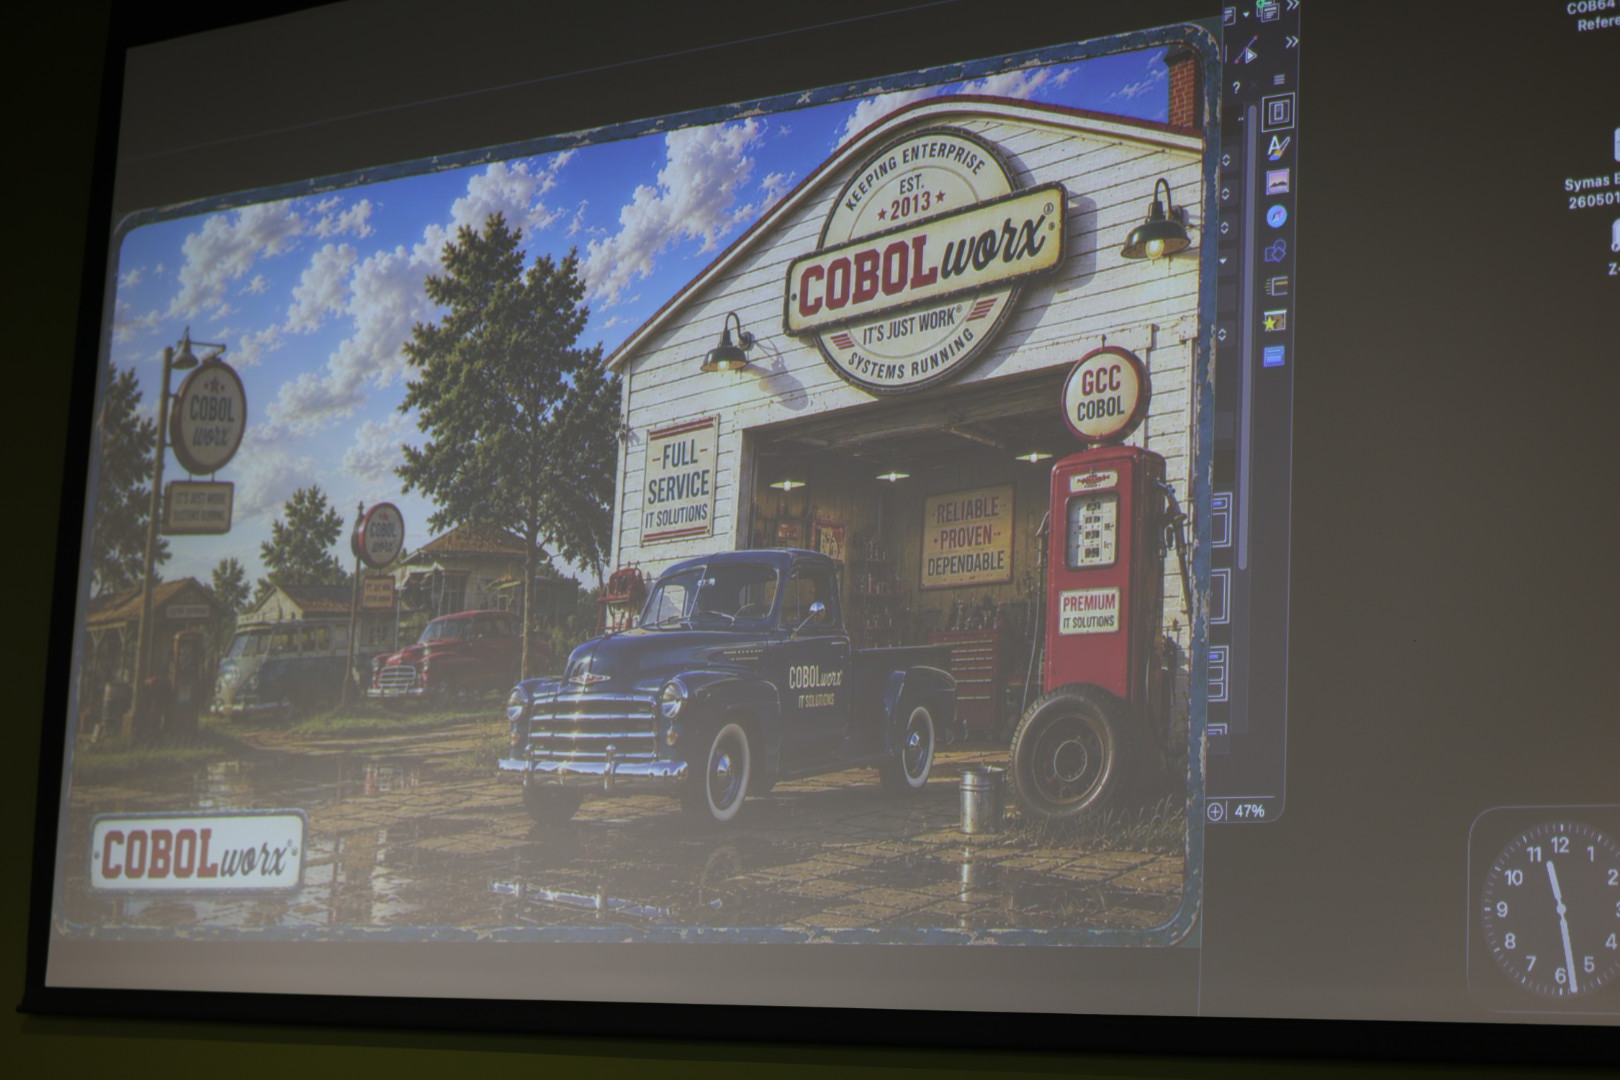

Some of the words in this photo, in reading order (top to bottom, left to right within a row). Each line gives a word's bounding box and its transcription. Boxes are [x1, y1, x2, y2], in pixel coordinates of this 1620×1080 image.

[845, 156, 898, 212] KEEPING
[902, 142, 986, 176] ENTERPRISE
[899, 173, 925, 195] EST.
[1564, 176, 1610, 193] Symas
[890, 191, 931, 221] 2013
[862, 325, 885, 346] IT'S
[886, 317, 916, 339] JUST
[848, 351, 905, 380] SYSTEMS
[911, 327, 975, 378] RUNNING
[1081, 364, 1121, 396] GCC
[190, 395, 235, 423] COBOL
[1077, 396, 1125, 422] COBOL
[662, 438, 698, 470] FULL
[647, 469, 710, 505] SERVICE
[645, 511, 655, 529] IT
[656, 503, 708, 527] SOLUTIONS
[937, 496, 999, 524] RELIABLE
[940, 524, 992, 550] PROVEN
[928, 550, 1005, 577] DEPENDABLE
[1063, 593, 1116, 612] PREMIUM
[1063, 617, 1071, 629] IT
[1072, 615, 1115, 629] SOLUTIONS
[798, 695, 804, 708] IT
[1234, 804, 1265, 818] 47%
[1551, 836, 1570, 853] 12
[1526, 846, 1542, 862] 11
[1587, 846, 1594, 862] 1
[1504, 869, 1523, 886] 10
[1608, 869, 1619, 886] 2
[1496, 901, 1508, 918] 9
[1504, 932, 1516, 949] 8
[1605, 933, 1618, 950] 4
[1526, 955, 1537, 972] 7
[1583, 956, 1595, 973] 5
[1554, 968, 1567, 984] 6
